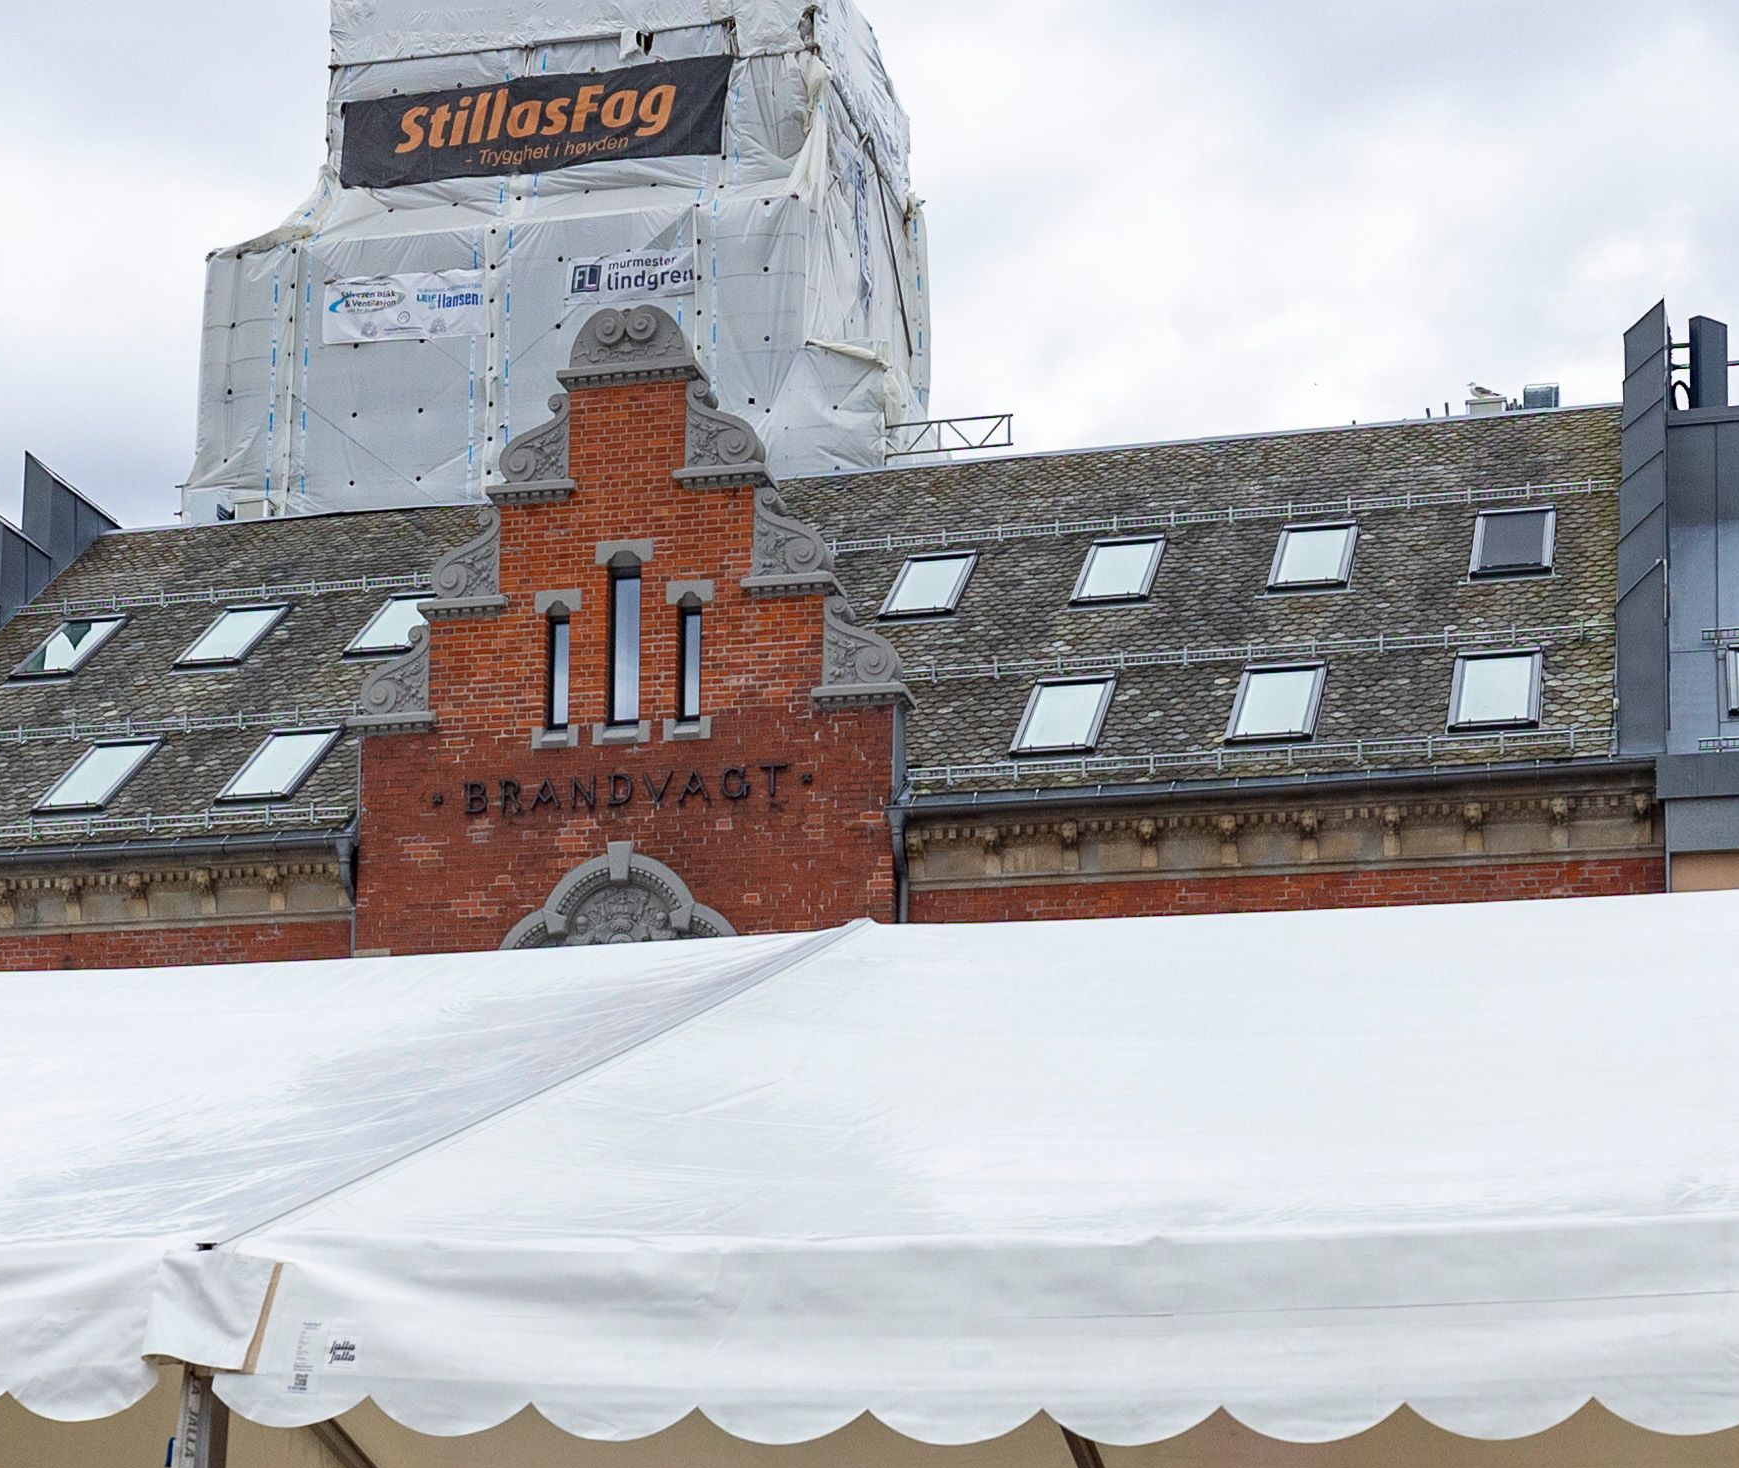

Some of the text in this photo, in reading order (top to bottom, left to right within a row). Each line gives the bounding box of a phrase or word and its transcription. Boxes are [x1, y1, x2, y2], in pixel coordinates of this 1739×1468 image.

[394, 84, 677, 154] StillasFag
[479, 144, 550, 167] Trygghet
[554, 142, 562, 158] i
[565, 135, 630, 161] høyden
[608, 255, 678, 271] murmester
[607, 268, 694, 292] lindgren
[463, 763, 789, 815] BRANDVAGT
